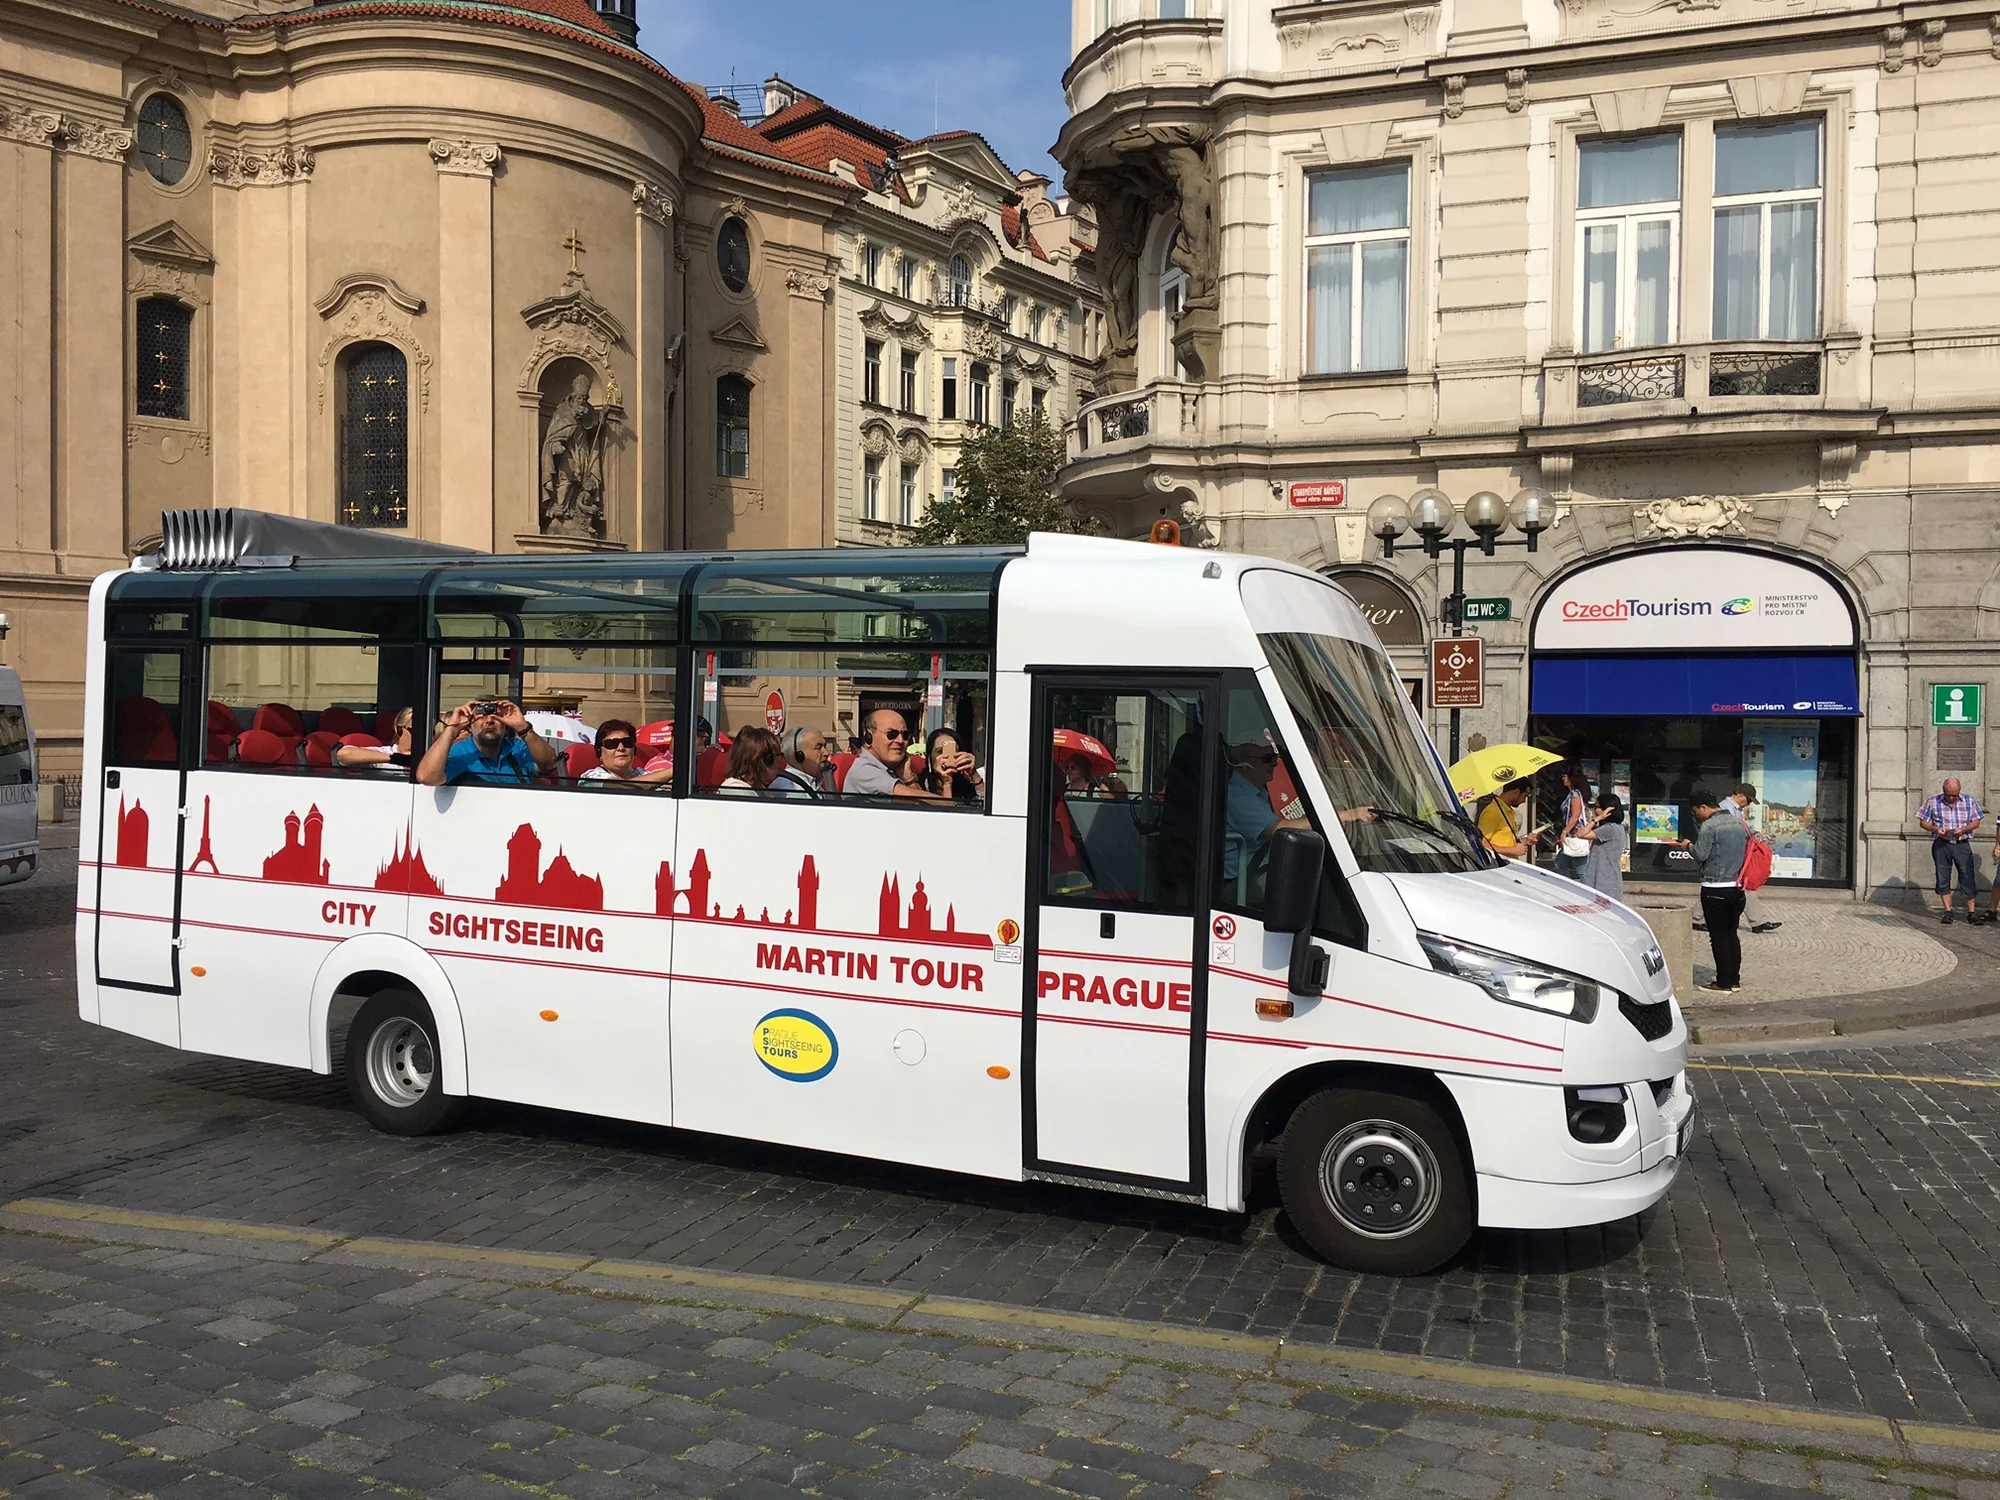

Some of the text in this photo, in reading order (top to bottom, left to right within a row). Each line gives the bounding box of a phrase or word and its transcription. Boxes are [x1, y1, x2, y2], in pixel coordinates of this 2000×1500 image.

[1480, 603, 1495, 616] WC
[1562, 599, 1712, 618] CzechTourism
[1711, 702, 1786, 712] CzechTourism
[1668, 850, 1694, 859] cze
[321, 900, 1192, 1013] CITY SIGHTSEEING MARTIN TOUR PRAGUE
[762, 1027, 799, 1041] PRAGUE
[762, 1036, 823, 1054] SIGHTSEEING
[762, 1046, 798, 1059] TOURS
